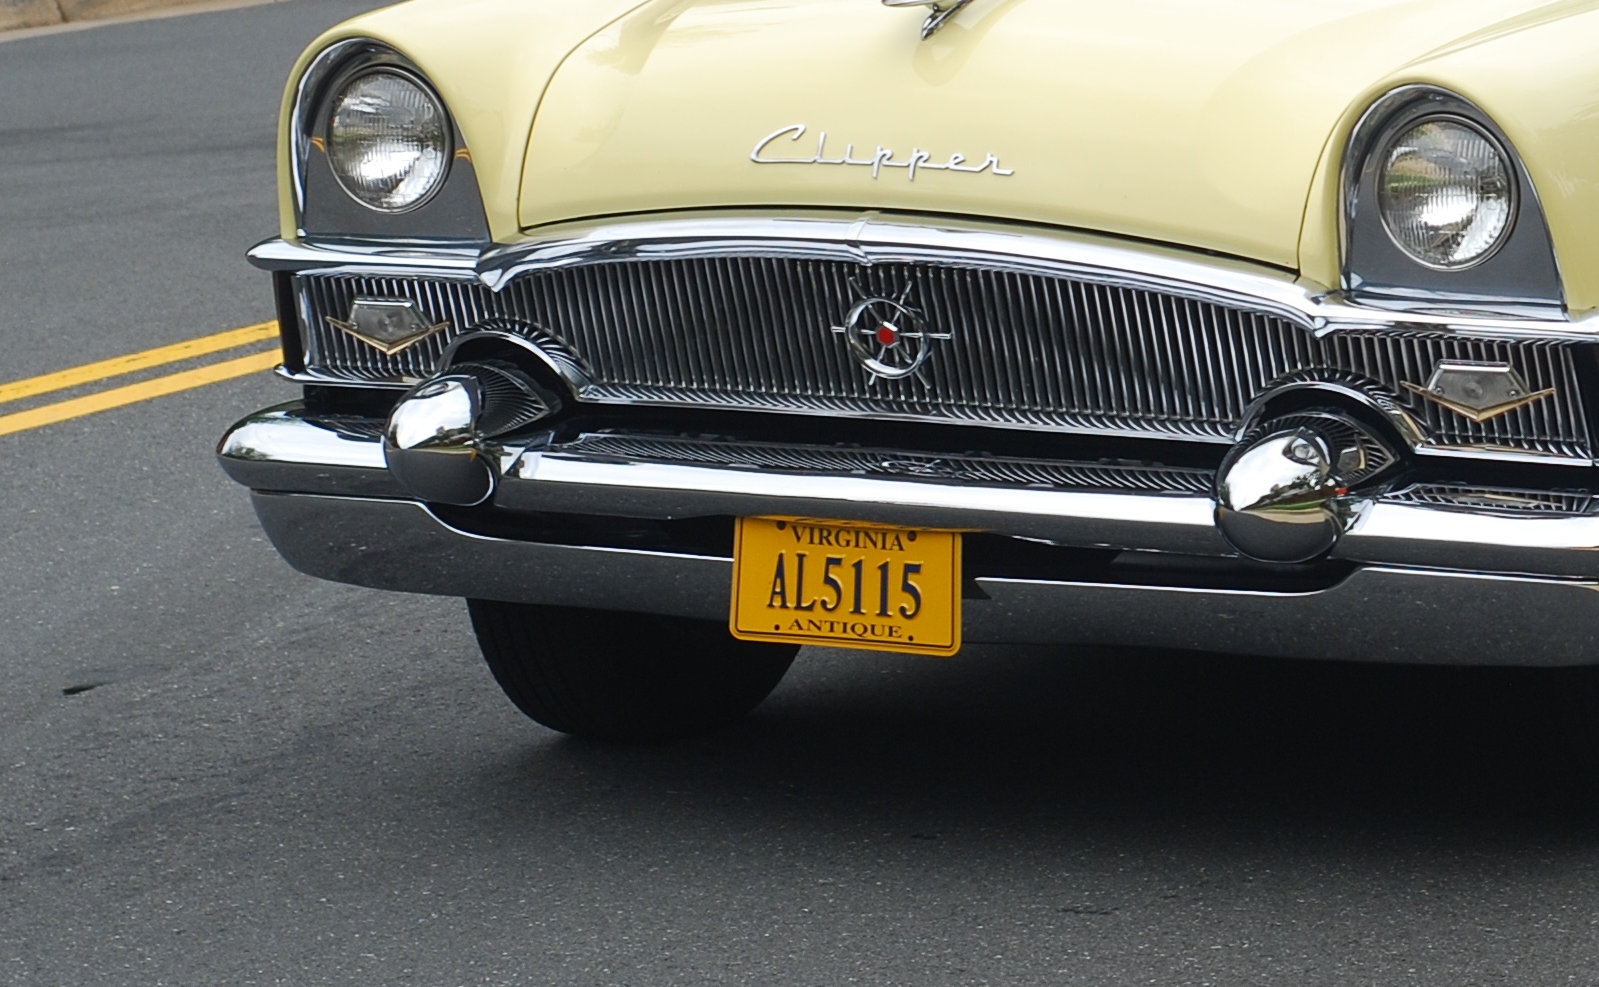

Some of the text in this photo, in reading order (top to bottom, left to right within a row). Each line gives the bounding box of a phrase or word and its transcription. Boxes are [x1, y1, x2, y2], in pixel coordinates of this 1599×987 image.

[750, 123, 1015, 181] Clipper
[790, 525, 906, 552] VIRGINIA
[767, 551, 923, 620] AL5115
[788, 618, 903, 639] ANTIQUE
